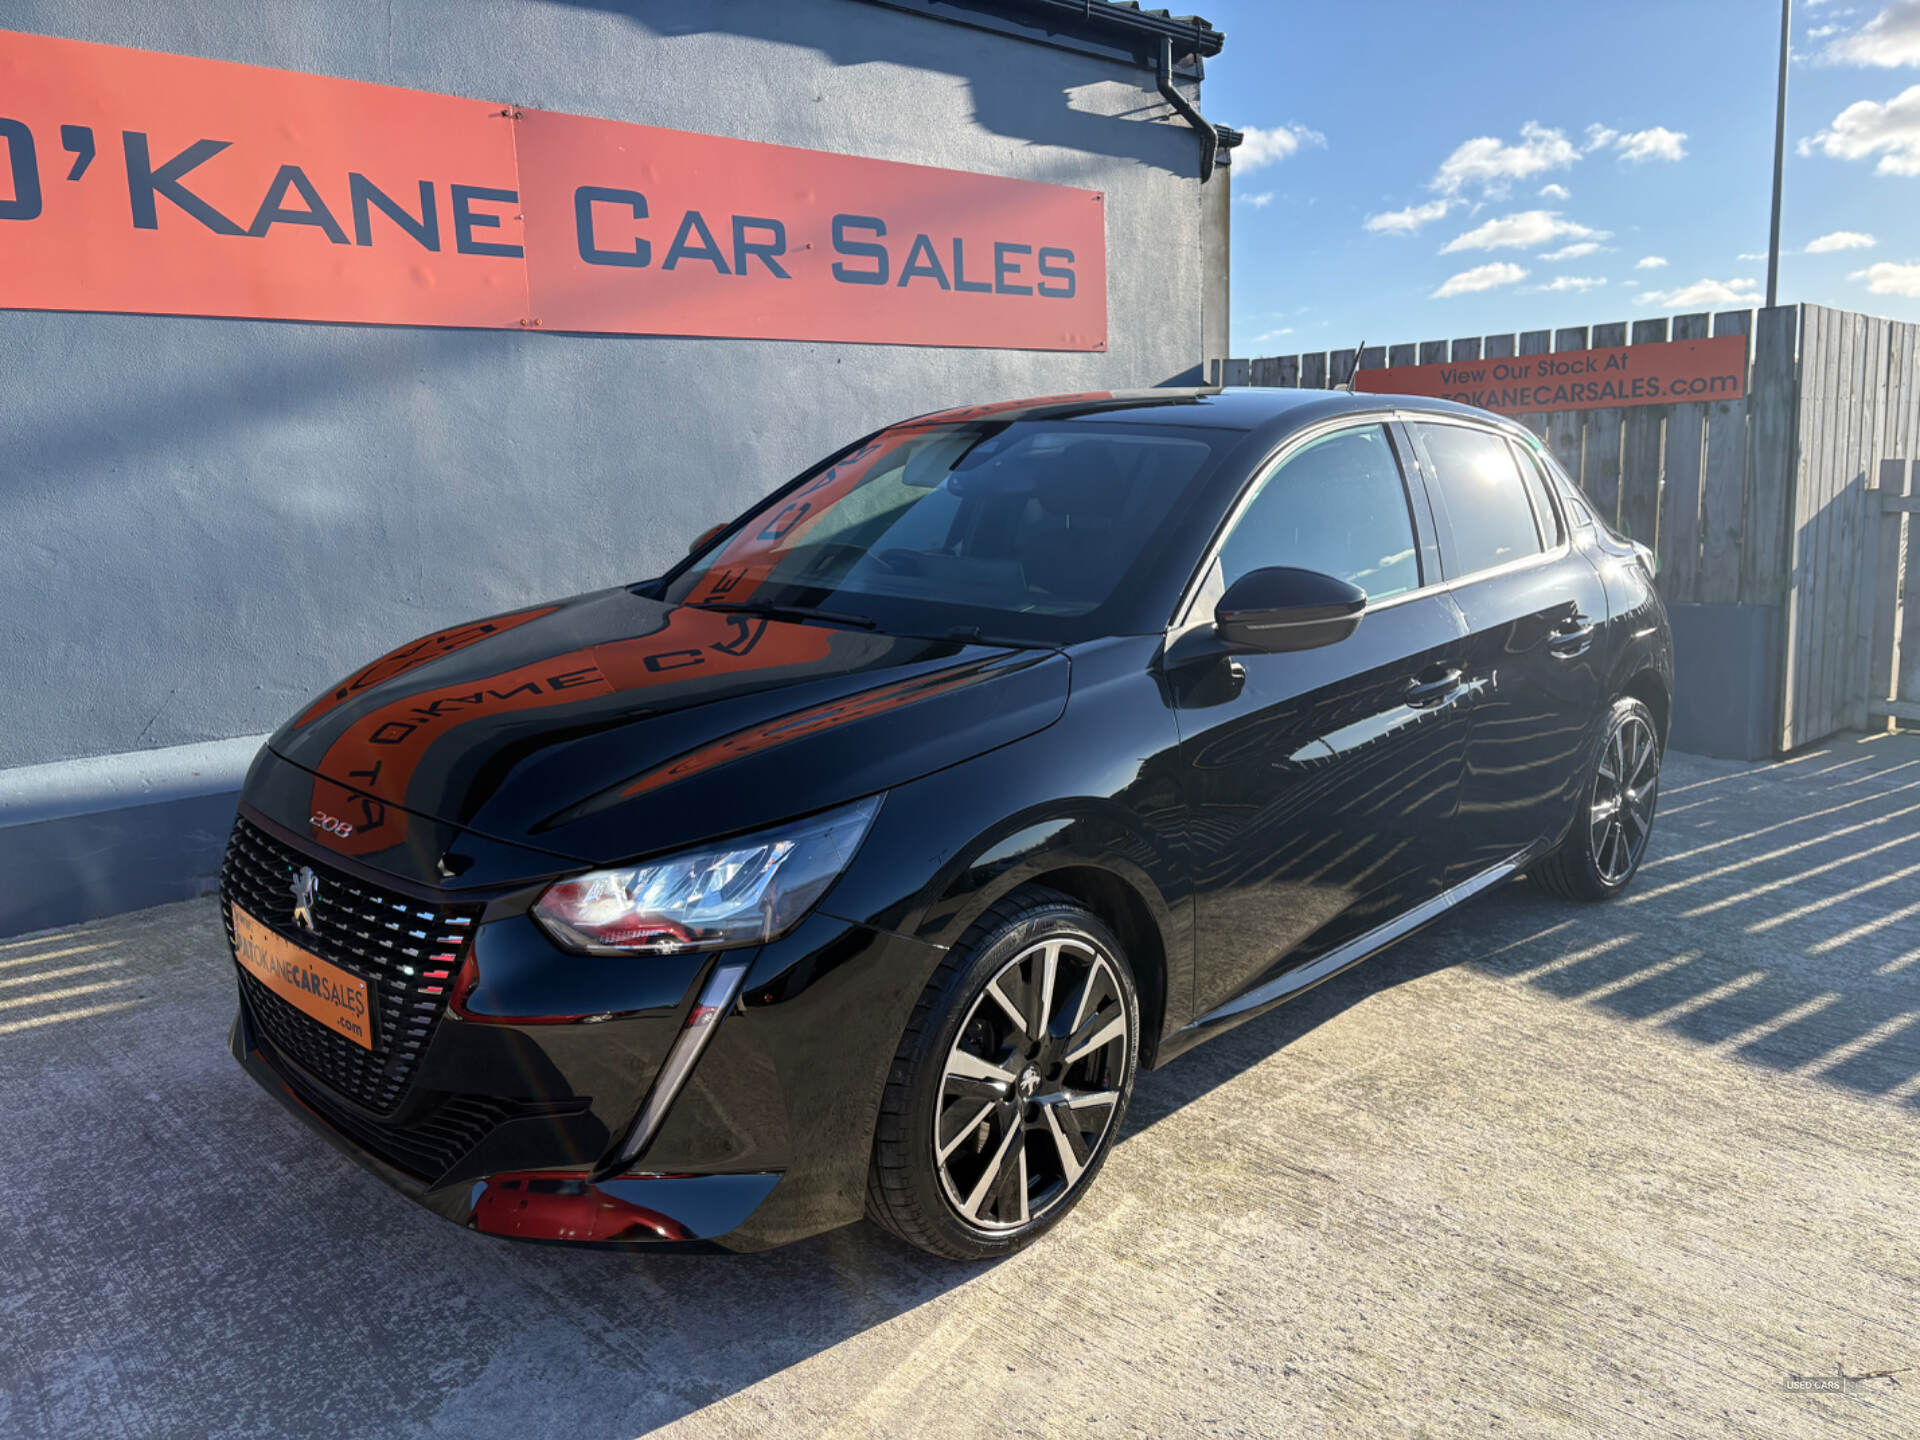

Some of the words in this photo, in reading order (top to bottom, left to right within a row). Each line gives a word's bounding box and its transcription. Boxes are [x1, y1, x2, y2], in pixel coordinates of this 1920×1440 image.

[575, 186, 792, 279] CAR
[831, 213, 1077, 299] SALES
[1441, 368, 1486, 385] View
[1492, 363, 1531, 381] Our
[1537, 356, 1598, 377] Stock
[1604, 352, 1629, 371] At
[309, 811, 353, 839] 208
